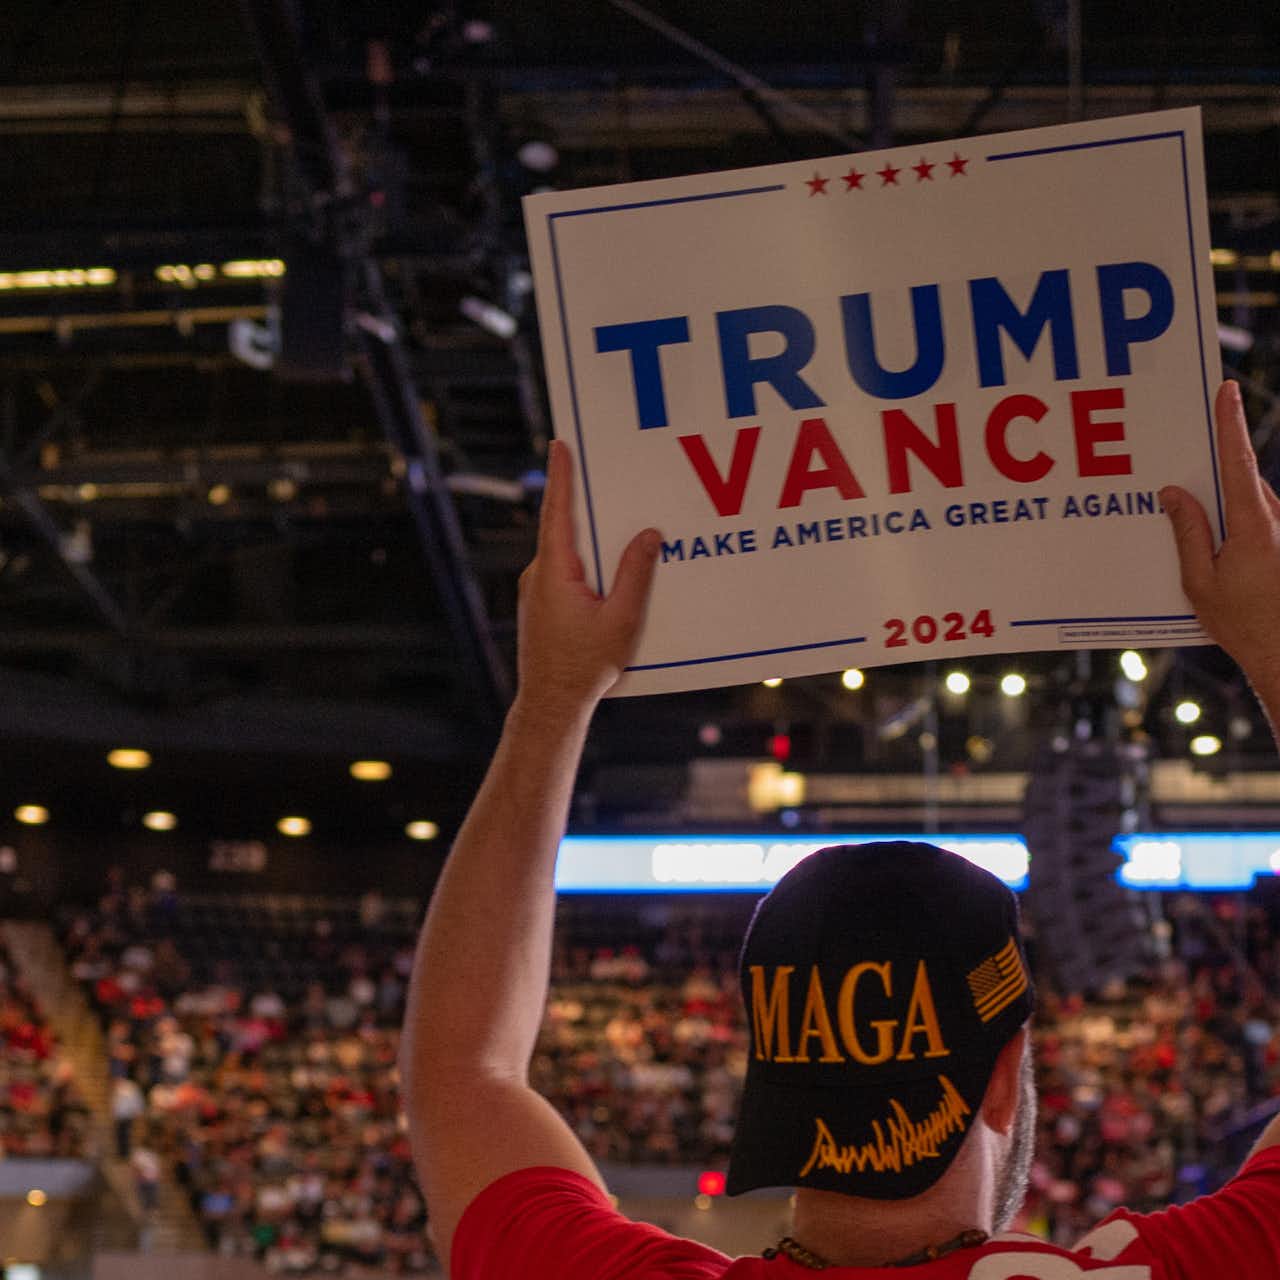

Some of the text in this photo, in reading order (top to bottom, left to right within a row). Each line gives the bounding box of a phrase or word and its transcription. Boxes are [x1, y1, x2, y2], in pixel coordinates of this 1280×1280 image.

[594, 261, 1175, 431] TRUMP
[678, 388, 1133, 517] VANCE
[660, 491, 1165, 563] MAKE AMERICA GREAT AGAIN
[883, 609, 995, 648] 2024
[750, 960, 951, 1065] MAGA
